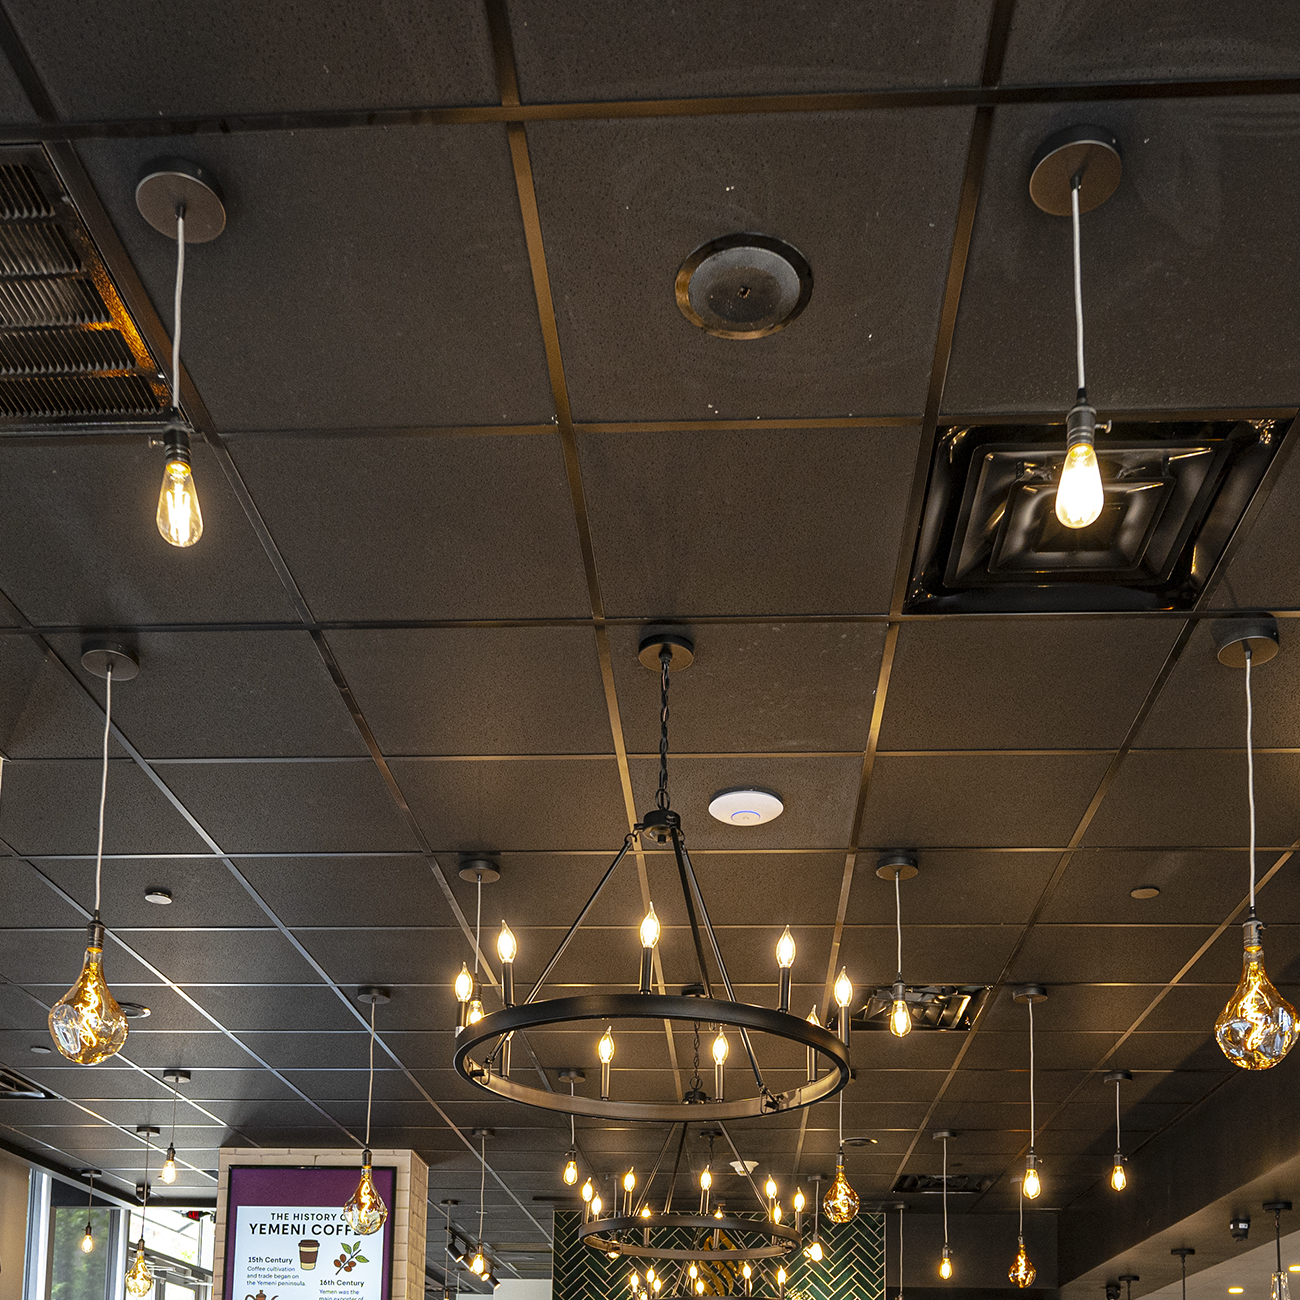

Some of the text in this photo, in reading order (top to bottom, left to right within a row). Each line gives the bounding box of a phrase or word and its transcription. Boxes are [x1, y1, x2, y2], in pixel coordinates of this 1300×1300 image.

[270, 1212, 290, 1221] THE
[293, 1213, 337, 1222] HISTORY
[248, 1223, 306, 1236] YEMENI
[264, 1256, 293, 1265] Century
[336, 1279, 365, 1288] Century
